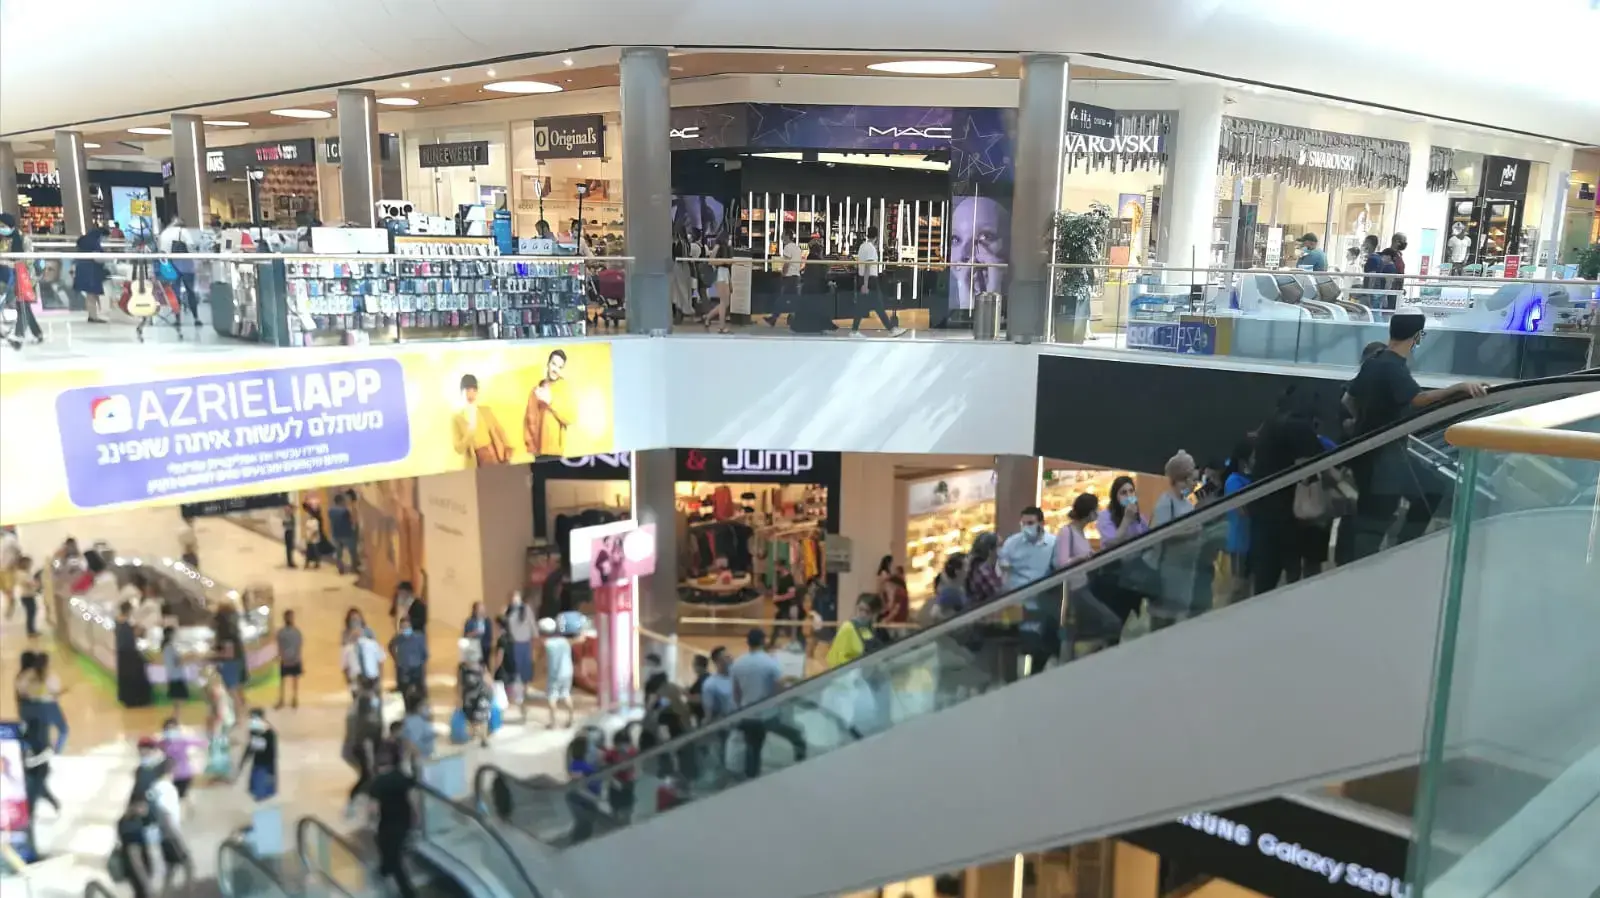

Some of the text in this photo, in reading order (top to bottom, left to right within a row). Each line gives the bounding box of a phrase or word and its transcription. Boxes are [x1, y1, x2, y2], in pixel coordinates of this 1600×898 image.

[869, 126, 952, 138] MAC
[1309, 151, 1355, 170] SWAROVSKI
[236, 417, 302, 446] לעשות
[309, 410, 384, 437] משתלם
[97, 437, 169, 465] שופינג
[175, 428, 232, 456] איתה
[1257, 832, 1345, 884] Galaxy
[1344, 862, 1391, 896] S20
